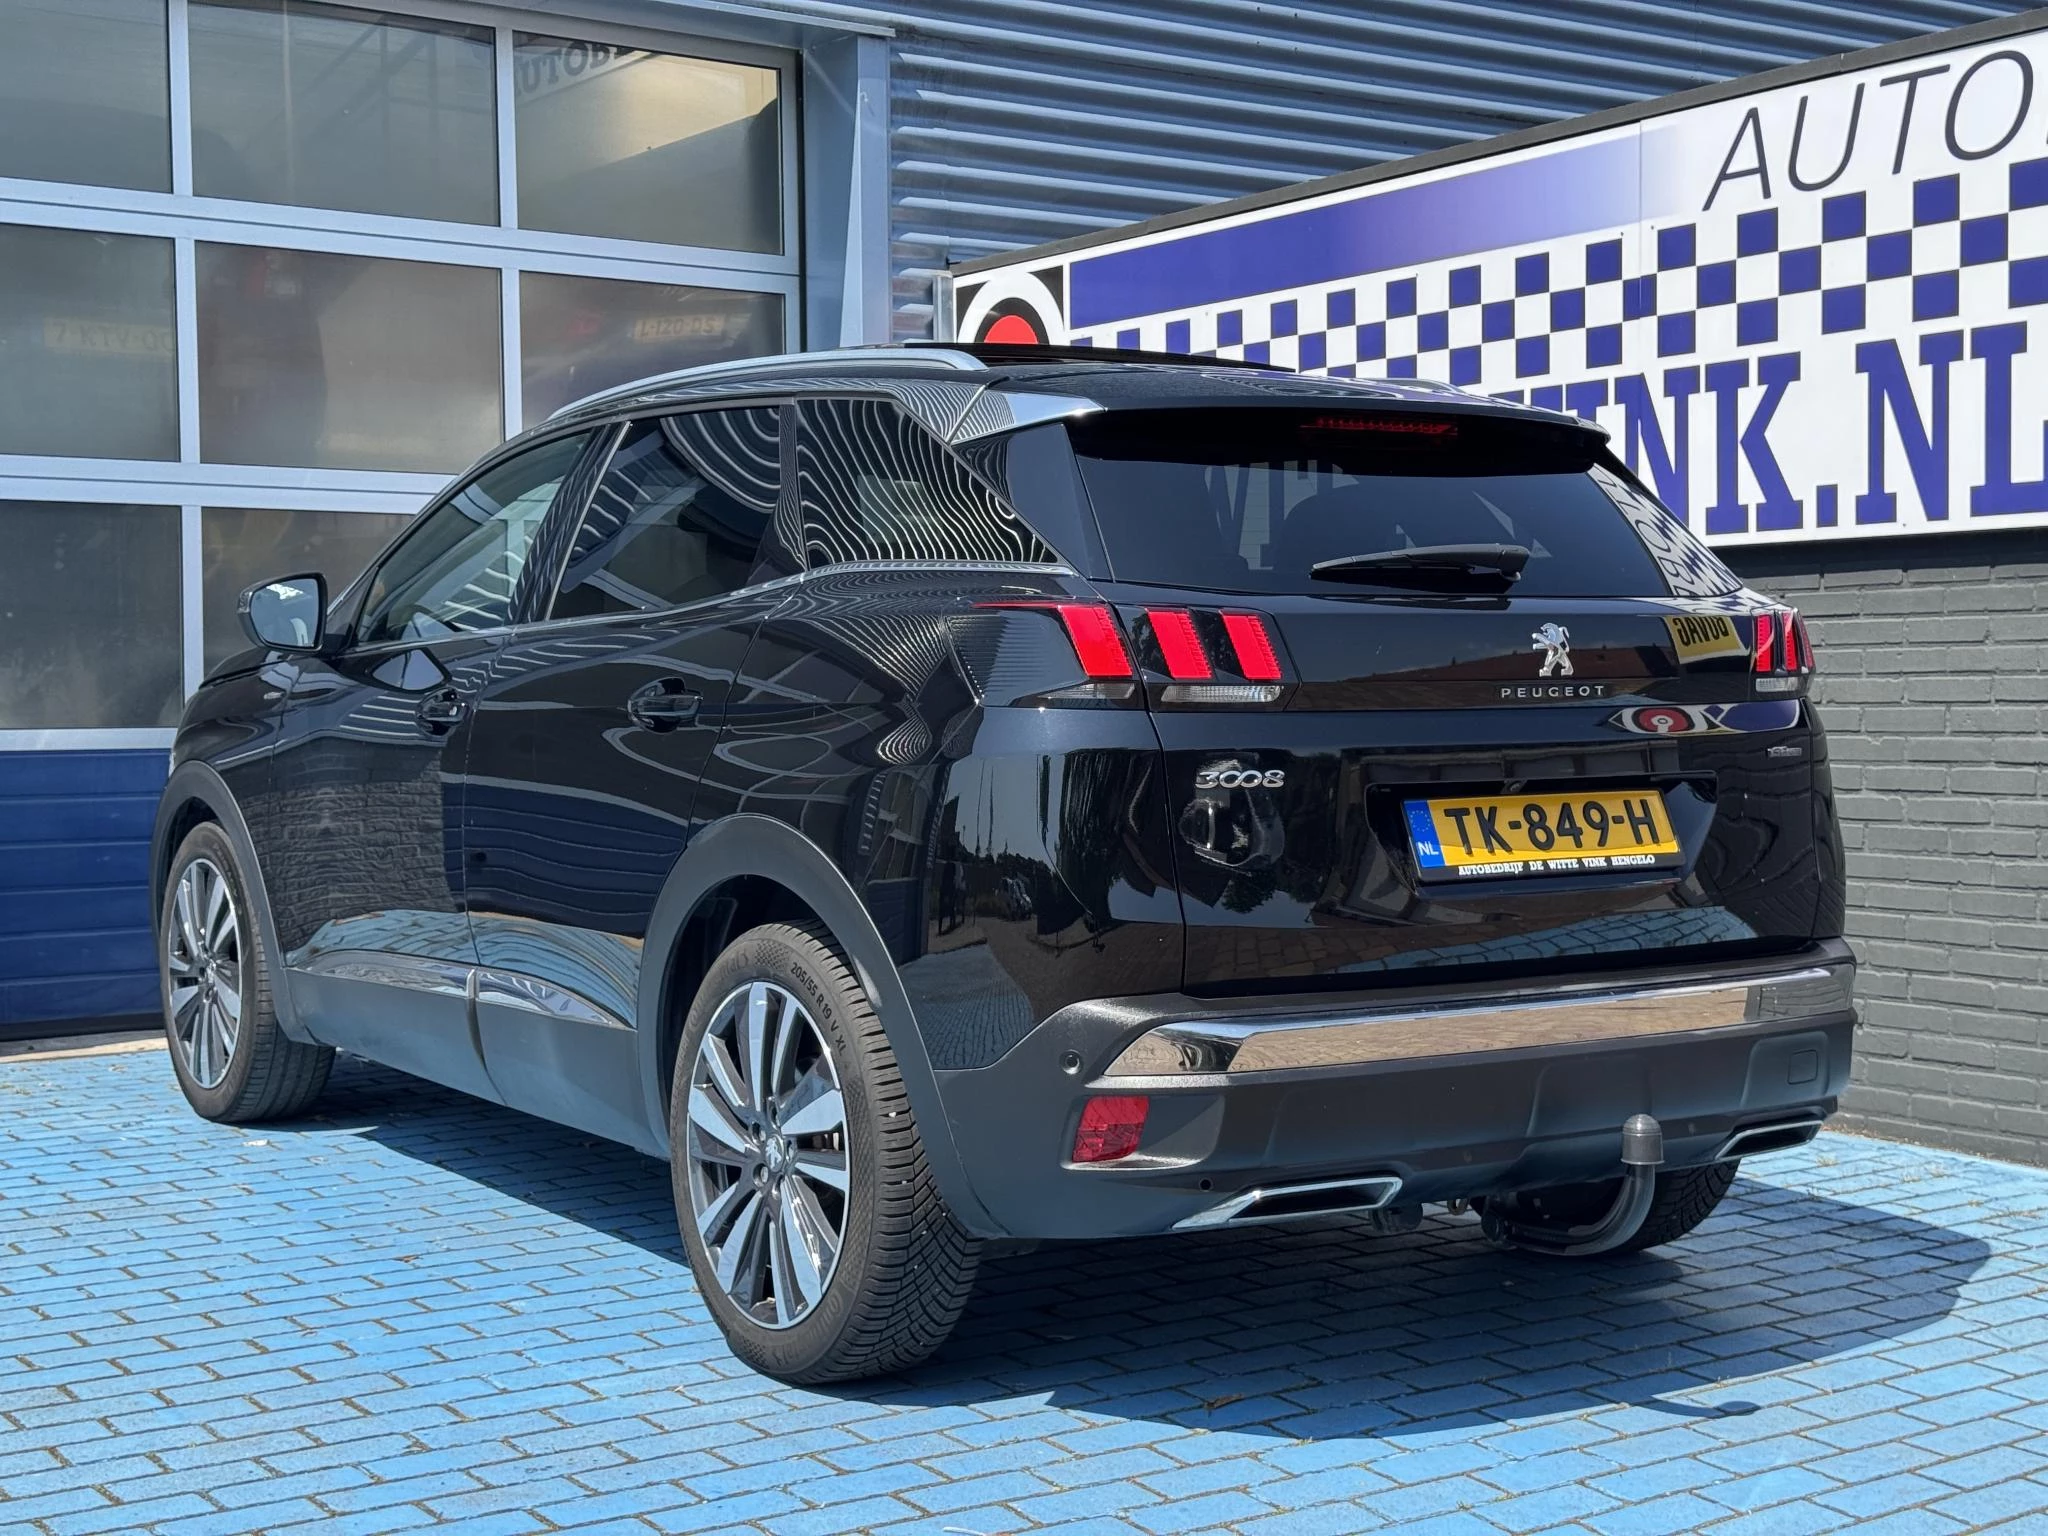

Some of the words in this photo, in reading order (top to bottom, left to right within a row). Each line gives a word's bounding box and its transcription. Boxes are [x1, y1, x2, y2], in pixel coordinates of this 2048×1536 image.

[1702, 50, 2048, 212] AUTO
[1488, 320, 2048, 536] NK.NL
[1501, 685, 1604, 698] PEUGEOT
[1195, 769, 1285, 789] 3008
[1443, 799, 1660, 856] TK-849-H
[1418, 841, 1439, 856] NL
[1458, 861, 1524, 876] AUTOBEDRIJF
[1529, 860, 1544, 871] DE
[1547, 858, 1579, 870] WITTE
[1583, 856, 1607, 867] VINK
[1612, 854, 1656, 866] HENGELO
[790, 961, 818, 997] 205/55
[816, 993, 825, 1008] R
[822, 1003, 832, 1019] 19
